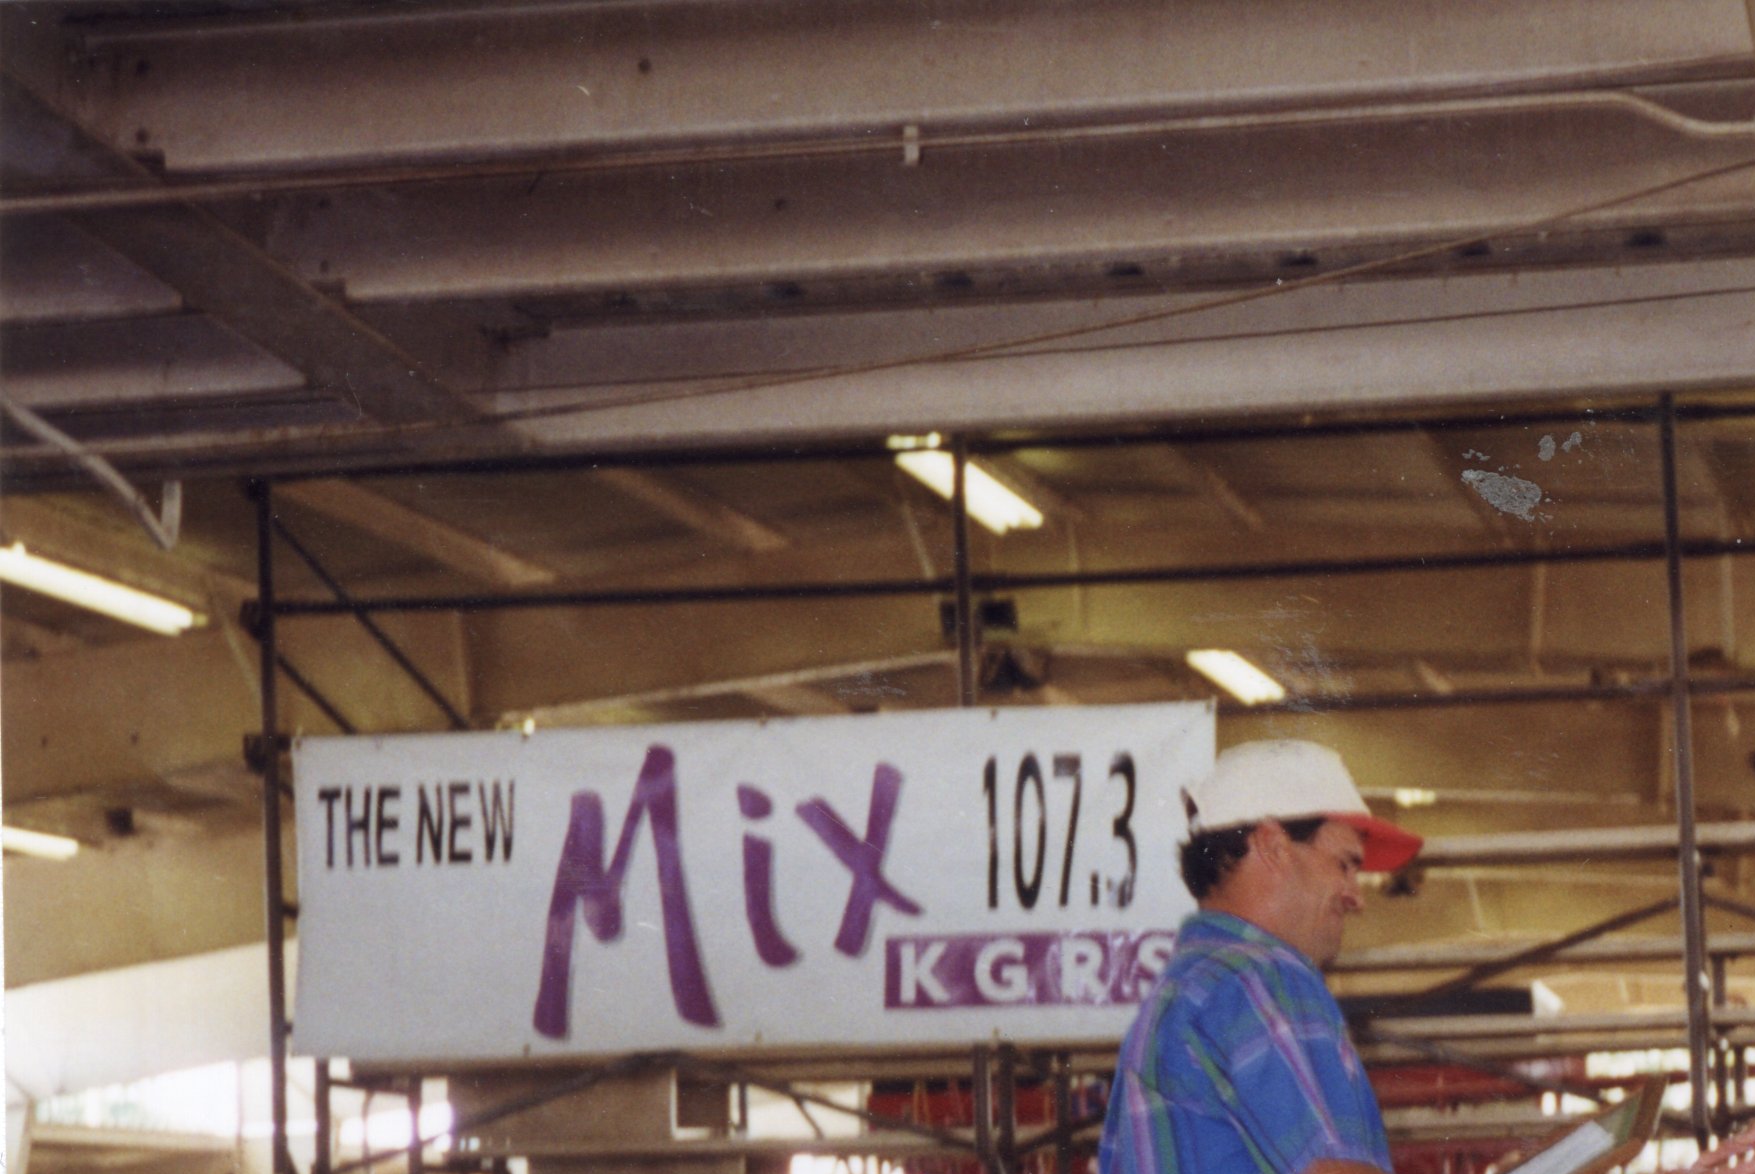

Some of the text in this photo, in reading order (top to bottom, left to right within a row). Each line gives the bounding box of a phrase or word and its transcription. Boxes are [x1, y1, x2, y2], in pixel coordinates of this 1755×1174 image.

[318, 779, 515, 868] THE NEW
[983, 751, 1138, 909] 107.3
